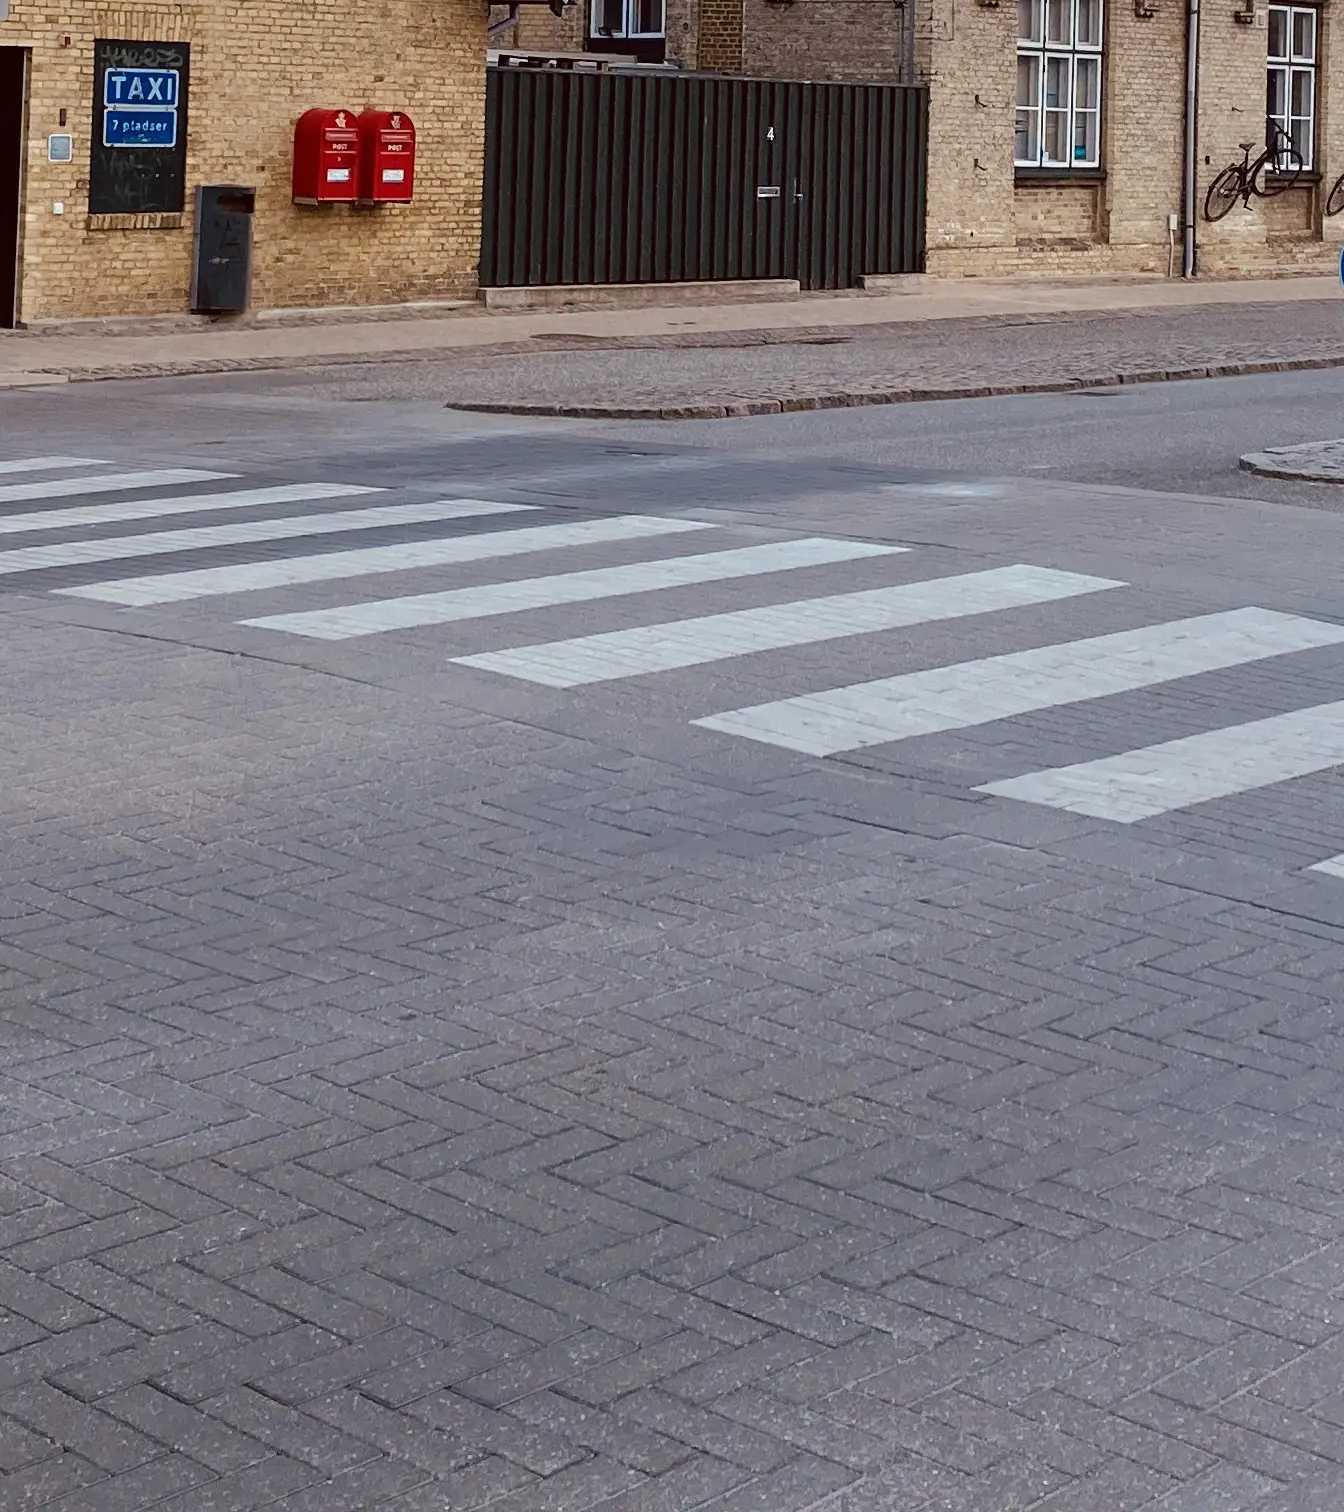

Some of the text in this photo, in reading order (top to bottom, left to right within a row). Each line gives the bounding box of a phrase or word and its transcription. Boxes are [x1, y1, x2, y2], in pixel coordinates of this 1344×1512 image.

[111, 76, 173, 101] TAXI
[112, 119, 119, 131] 7
[766, 126, 775, 141] 4
[332, 143, 348, 151] POST
[387, 144, 403, 152] POST
